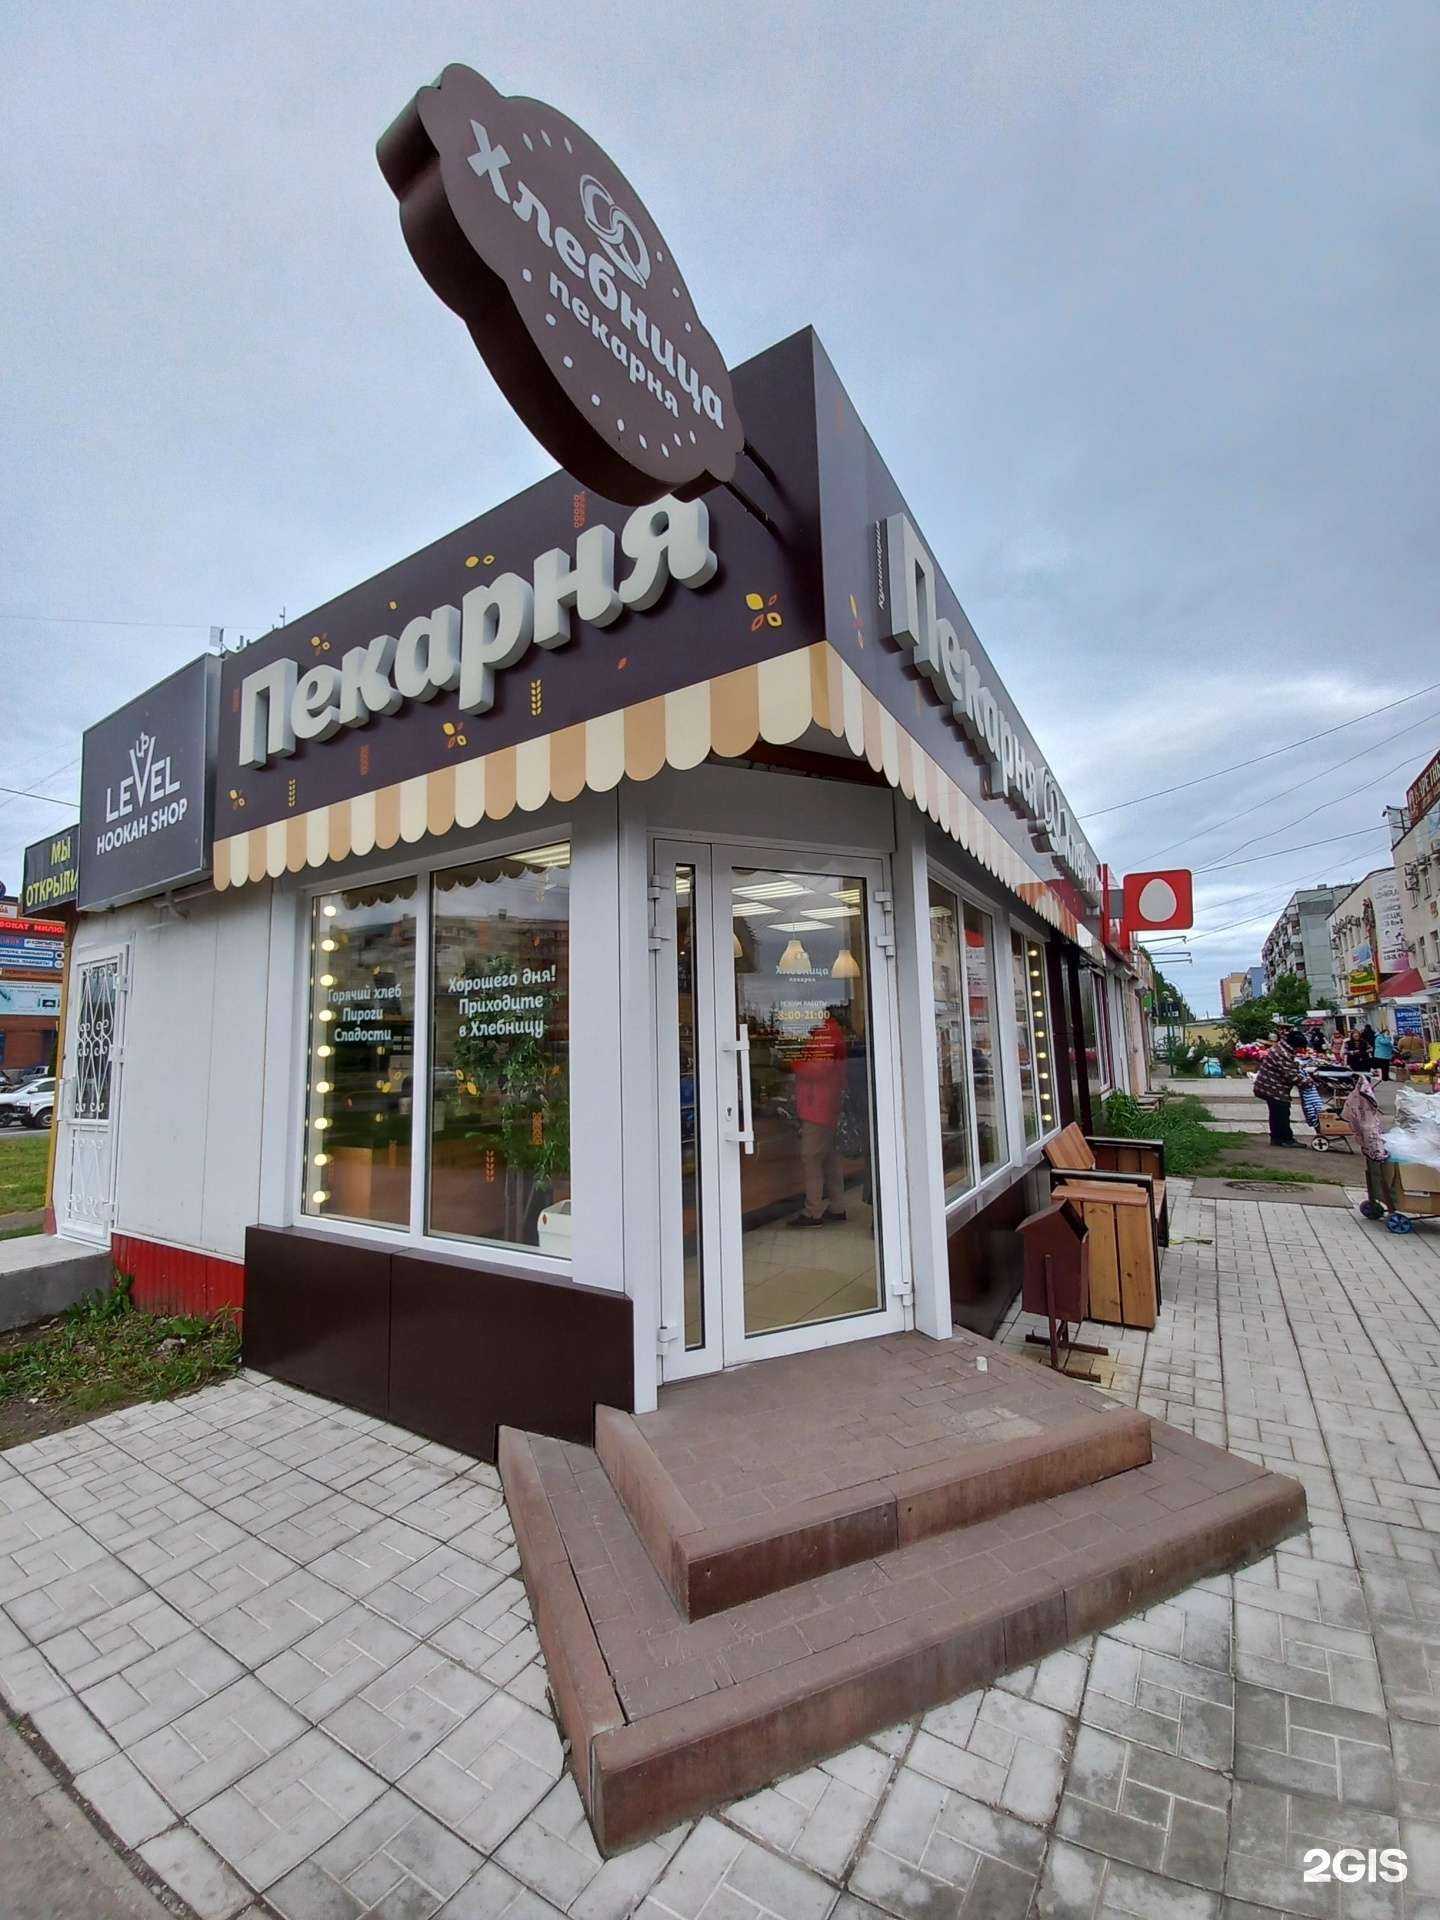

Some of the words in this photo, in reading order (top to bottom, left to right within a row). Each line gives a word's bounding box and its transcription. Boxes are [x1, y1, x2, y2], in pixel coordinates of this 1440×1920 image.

[548, 270, 680, 418] пекарня
[238, 493, 718, 770] Пекарня
[106, 735, 181, 824] LEVEL
[96, 815, 149, 856] HOOKAH
[150, 797, 188, 833] SHOP
[51, 836, 71, 866] МЫ
[34, 925, 65, 933] МИЛЮ
[448, 974, 518, 995] Хорошего
[522, 964, 556, 985] дня!
[328, 984, 371, 1005] Горячий
[373, 984, 402, 1000] хлеб
[459, 994, 544, 1018] Приходите
[342, 1007, 384, 1025] Пироги
[459, 1025, 467, 1037] в
[470, 1016, 544, 1039] Хлебницу
[334, 1027, 392, 1042] Сладости
